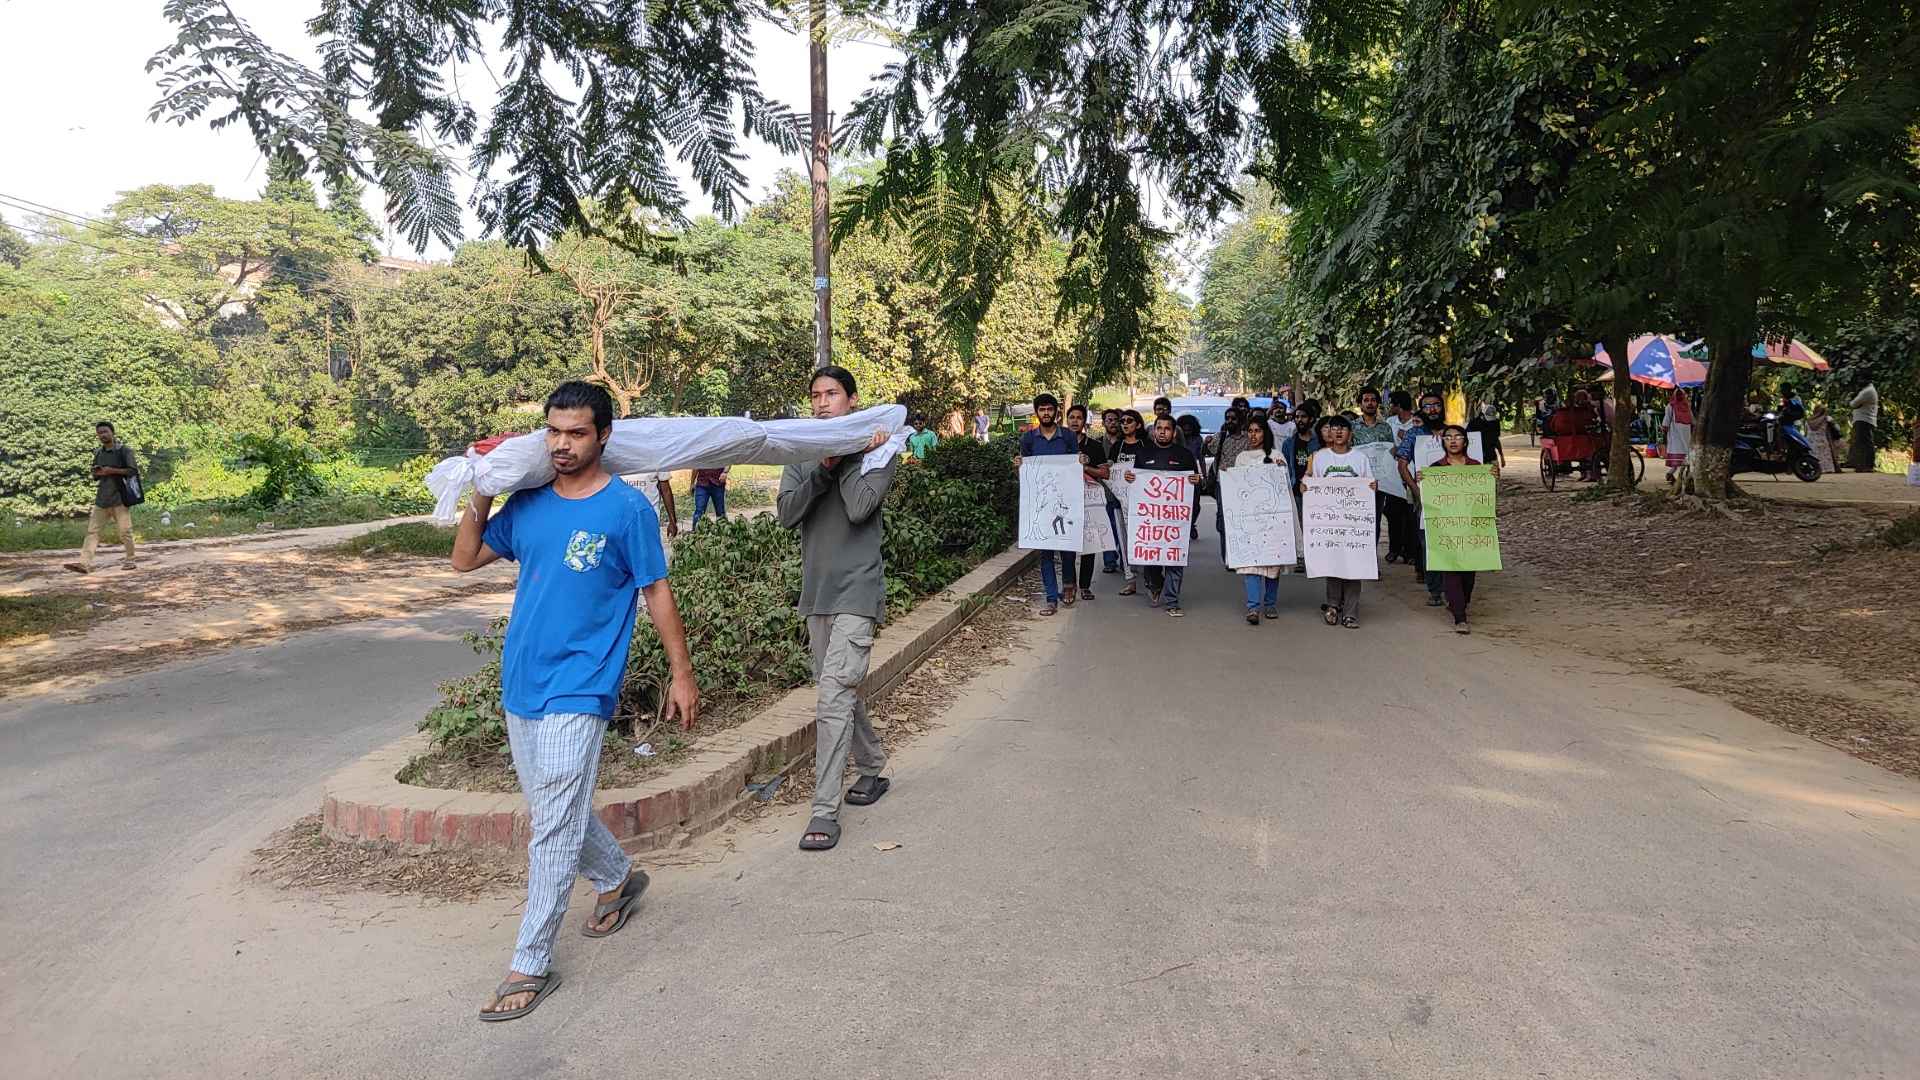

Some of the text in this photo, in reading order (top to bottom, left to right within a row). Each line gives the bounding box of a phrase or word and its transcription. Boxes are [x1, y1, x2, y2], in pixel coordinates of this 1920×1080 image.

[1143, 476, 1185, 502] ওরা
[1136, 503, 1191, 521] আমায়
[1136, 519, 1181, 543] বাঁচতে
[1134, 541, 1162, 561] দিল
